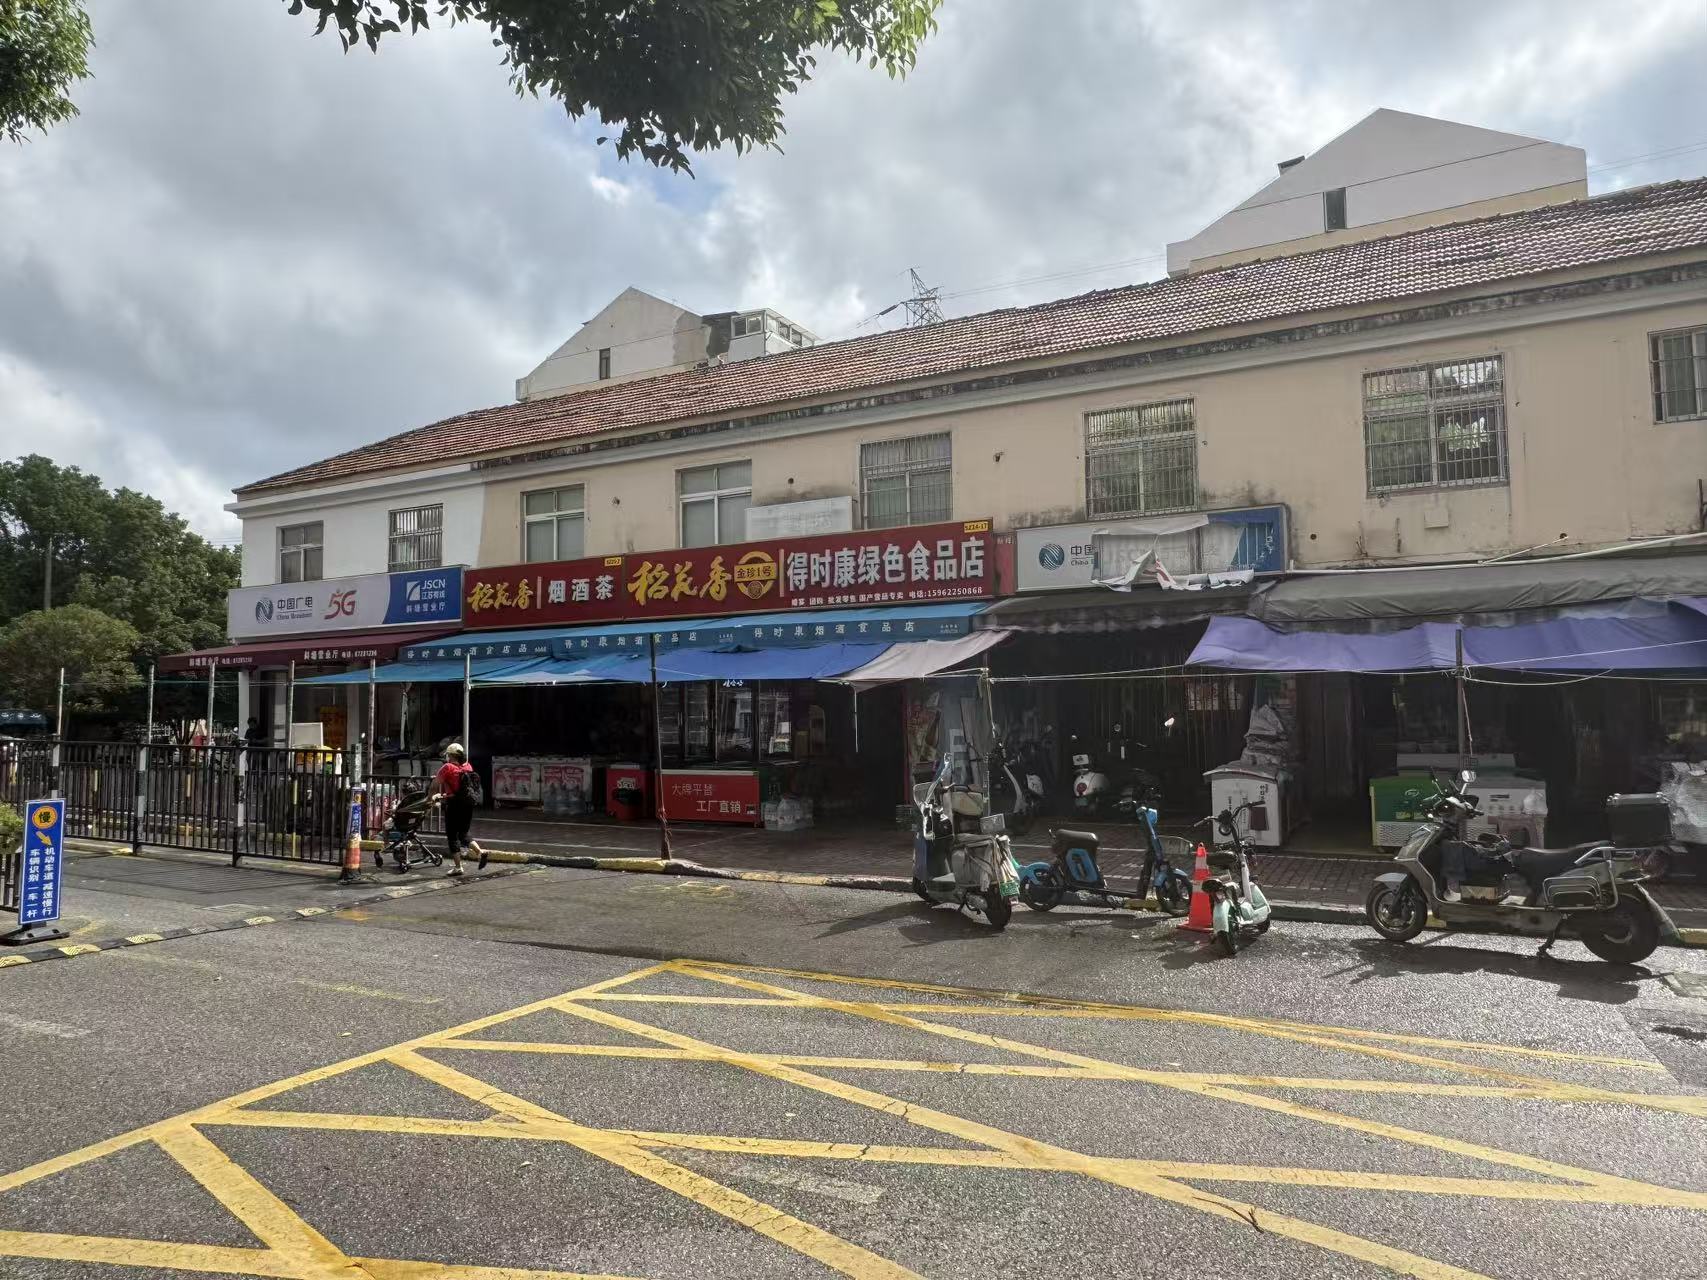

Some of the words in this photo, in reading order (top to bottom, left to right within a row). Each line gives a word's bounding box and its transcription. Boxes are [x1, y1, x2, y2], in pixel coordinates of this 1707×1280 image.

[786, 536, 985, 592] 得时康绿色食品店
[421, 578, 446, 590] JSCN
[548, 575, 614, 603] 烟酒茶
[627, 555, 731, 606] 稻花香
[277, 596, 313, 611] 中国广电
[324, 589, 357, 620] 5G
[467, 578, 533, 612] 稻花香
[754, 621, 915, 637] 得时康烟酒食品店
[39, 811, 51, 823] 慢
[696, 799, 741, 814] 工厂直销
